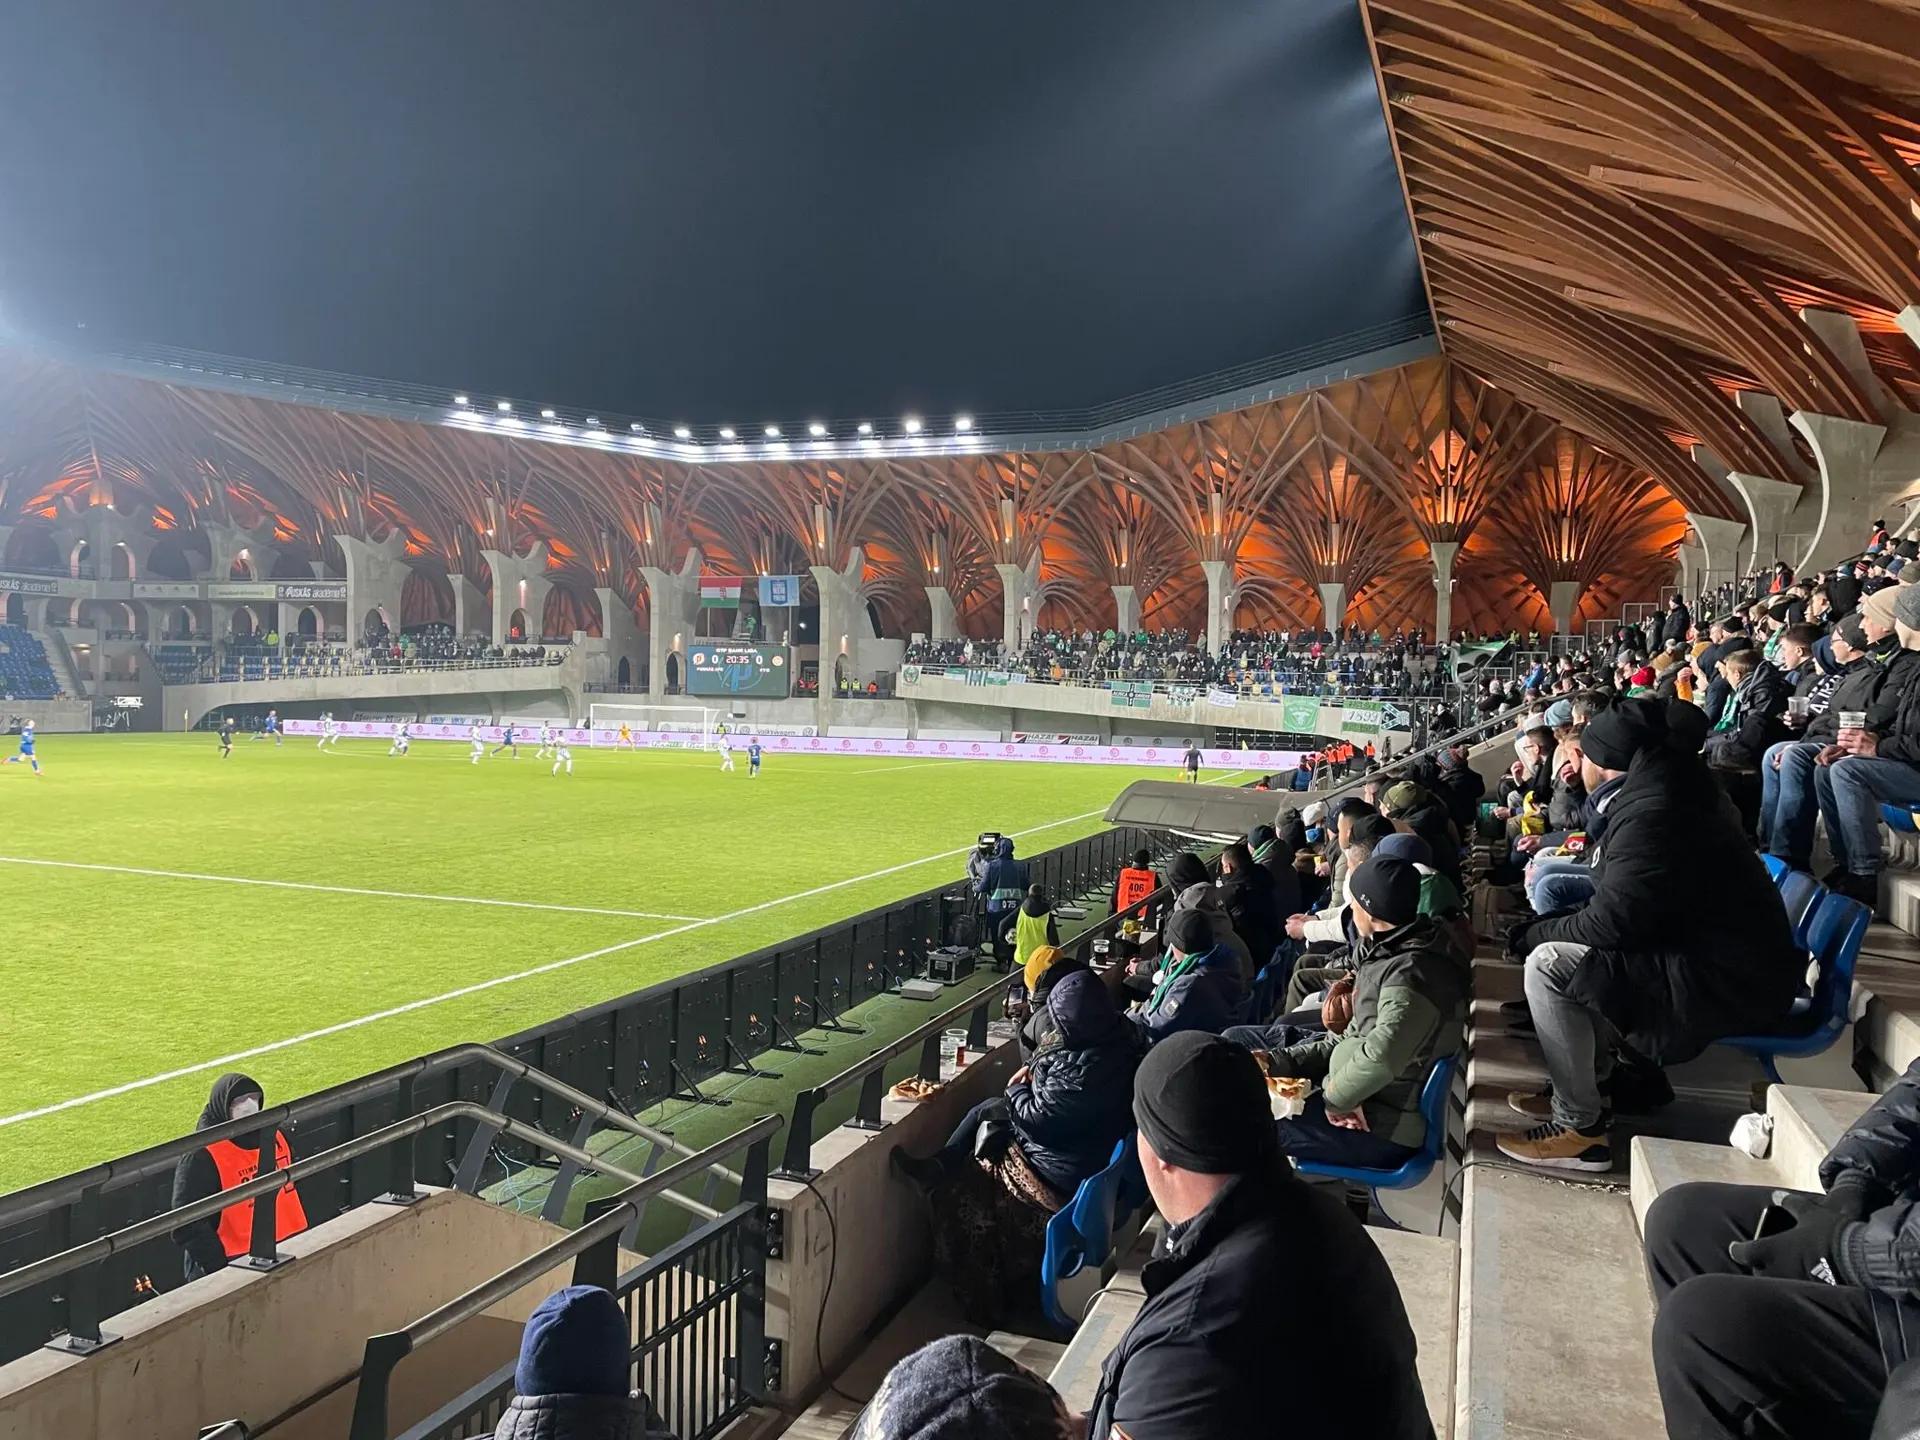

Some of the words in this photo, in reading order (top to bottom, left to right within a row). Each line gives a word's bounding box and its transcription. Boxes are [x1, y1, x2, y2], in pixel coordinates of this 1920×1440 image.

[711, 654, 719, 664] 0
[726, 655, 749, 664] 20:35
[755, 655, 763, 665] 0
[1027, 732, 1055, 740] HAZAI
[1129, 883, 1145, 892] 406
[1004, 889, 1016, 897] TV
